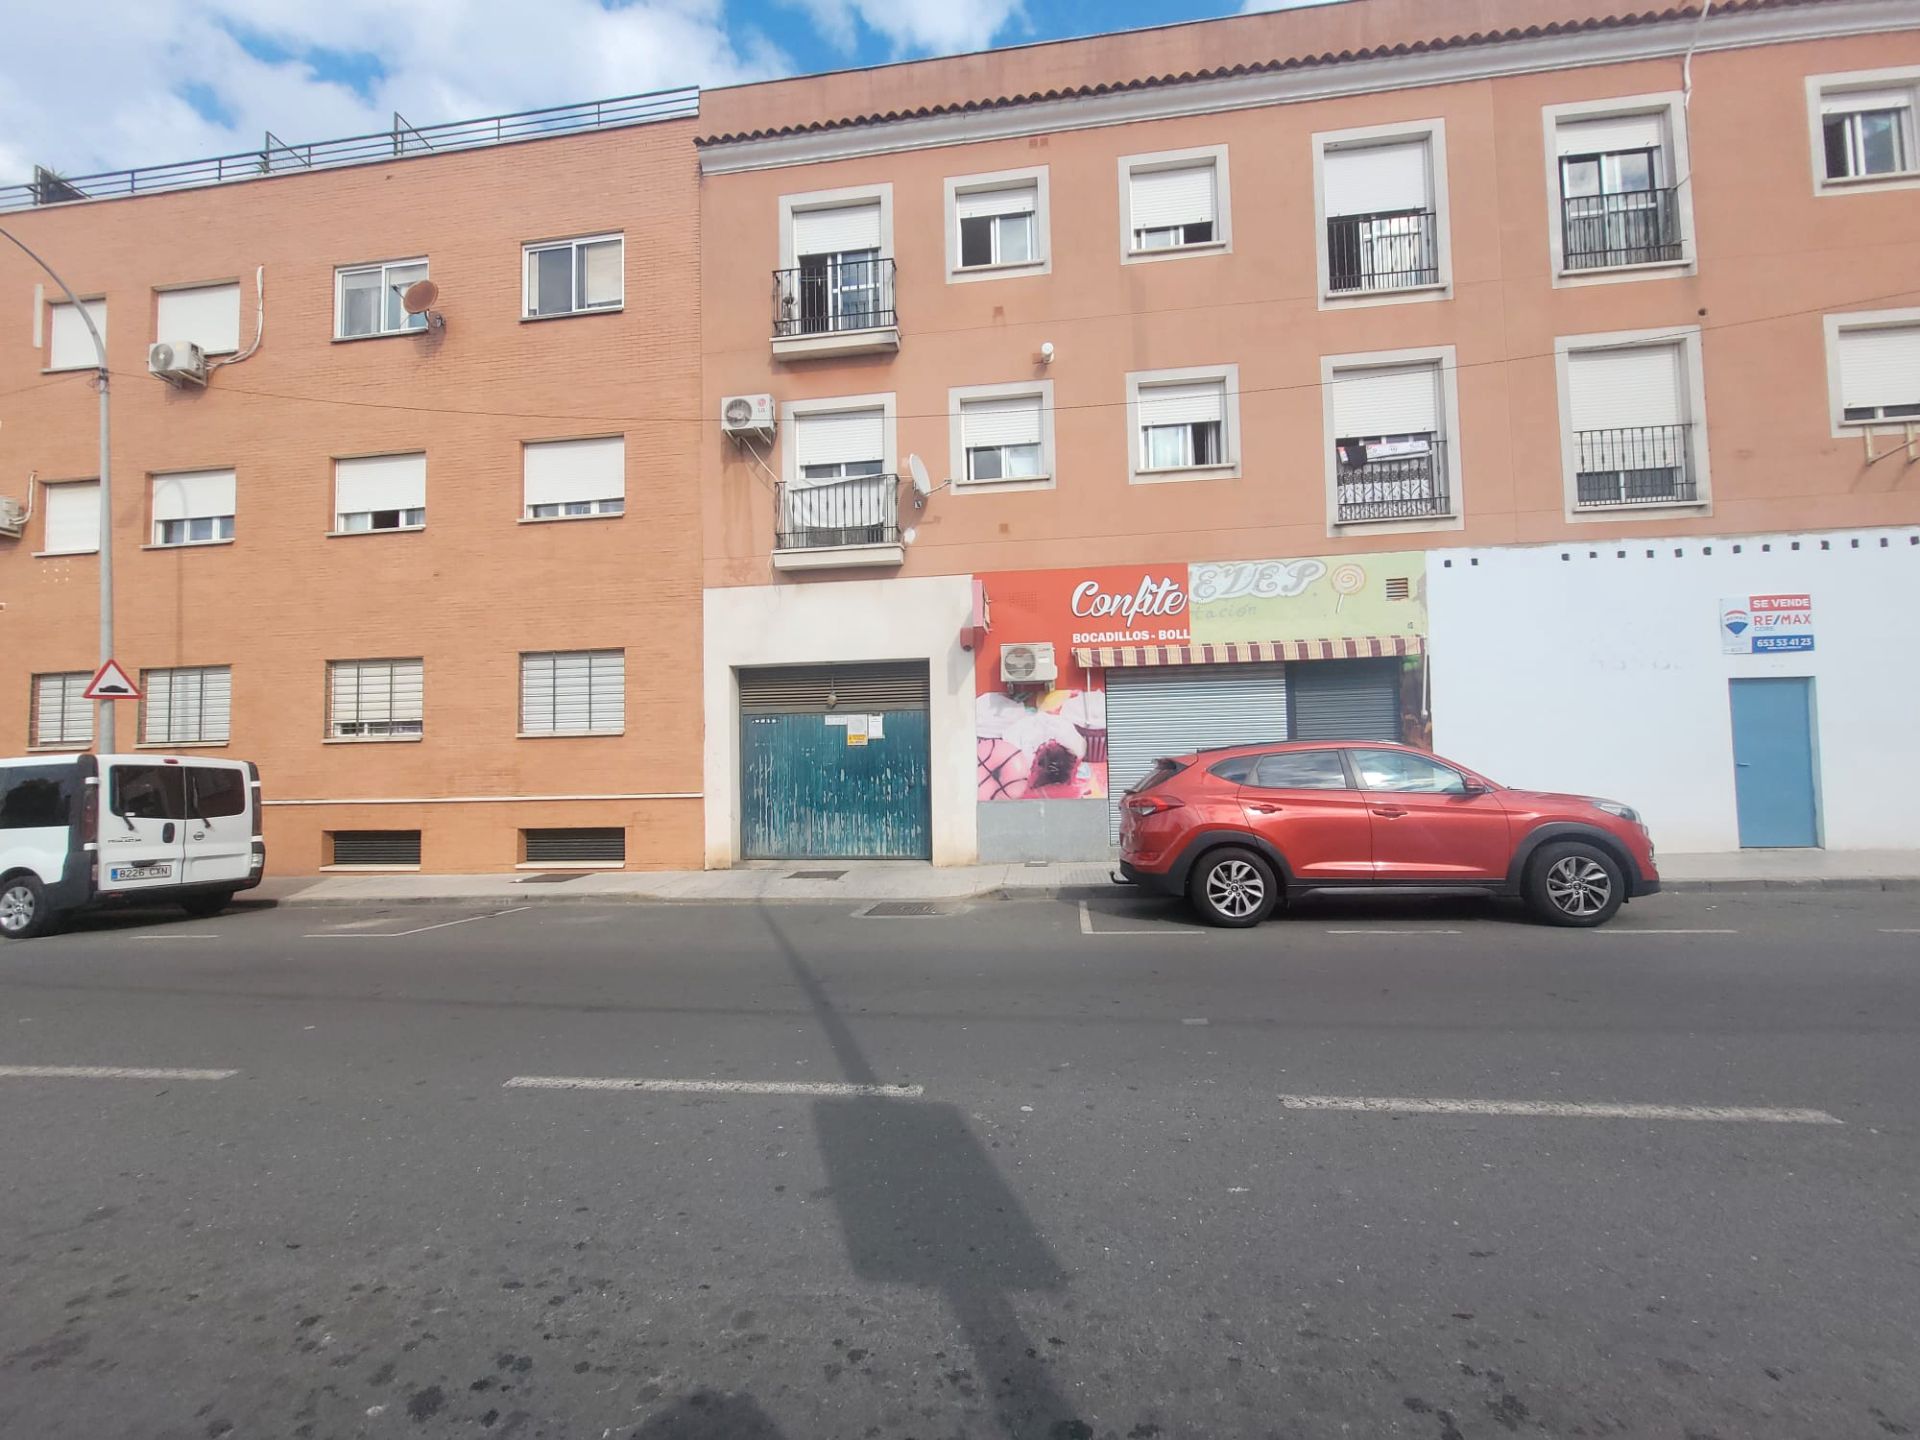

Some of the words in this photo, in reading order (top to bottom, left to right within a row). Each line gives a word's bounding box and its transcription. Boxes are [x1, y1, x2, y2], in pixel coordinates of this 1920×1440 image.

[1753, 599, 1769, 609] SE
[1771, 598, 1810, 608] VENDE
[1754, 614, 1811, 625] RE/MAX
[1072, 630, 1150, 644] BOCADILLOS
[1158, 629, 1190, 640] BOLL
[1757, 639, 1774, 647] 653
[1776, 638, 1787, 646] 53
[1789, 638, 1799, 646] 41
[119, 868, 145, 878] 8226
[149, 866, 168, 876] CXN
